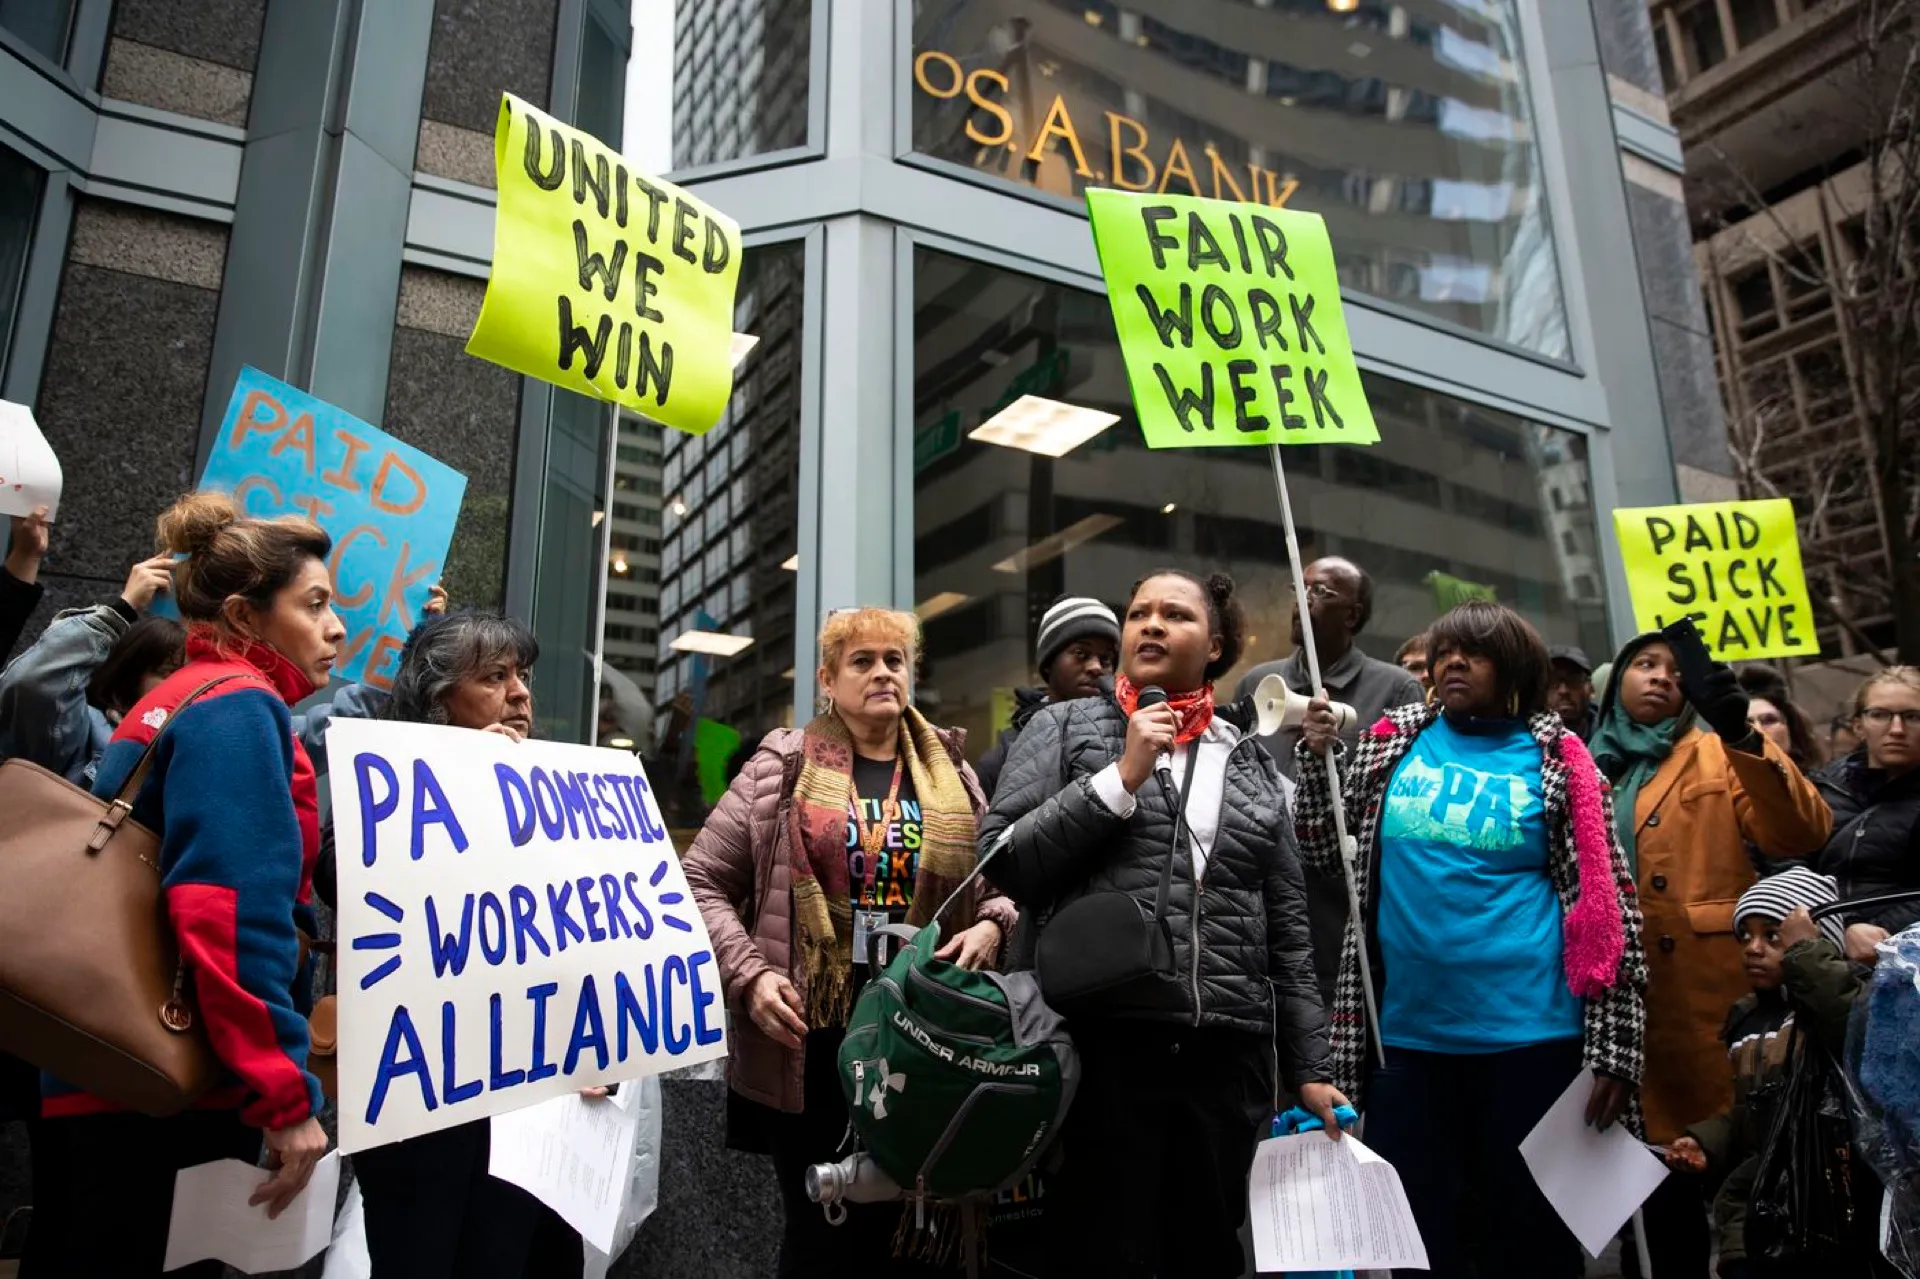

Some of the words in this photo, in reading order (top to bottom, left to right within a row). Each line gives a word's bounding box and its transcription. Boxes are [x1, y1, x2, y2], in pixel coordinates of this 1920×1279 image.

[523, 113, 730, 274] UNITED
[573, 219, 665, 324] WE
[1141, 205, 1295, 281] FAIR
[558, 295, 673, 406] WIN
[1136, 282, 1325, 355] WORK
[1153, 359, 1344, 433] WEEK
[230, 391, 427, 516] PAID
[1645, 511, 1761, 555] PAID
[1667, 557, 1787, 605] SICK
[353, 752, 470, 868] PA
[493, 763, 666, 849] DOMESTIC
[1429, 764, 1512, 836] PA
[424, 872, 654, 979] WORKERS
[364, 950, 723, 1126] ALLIANCE
[892, 1010, 955, 1062] UNDER
